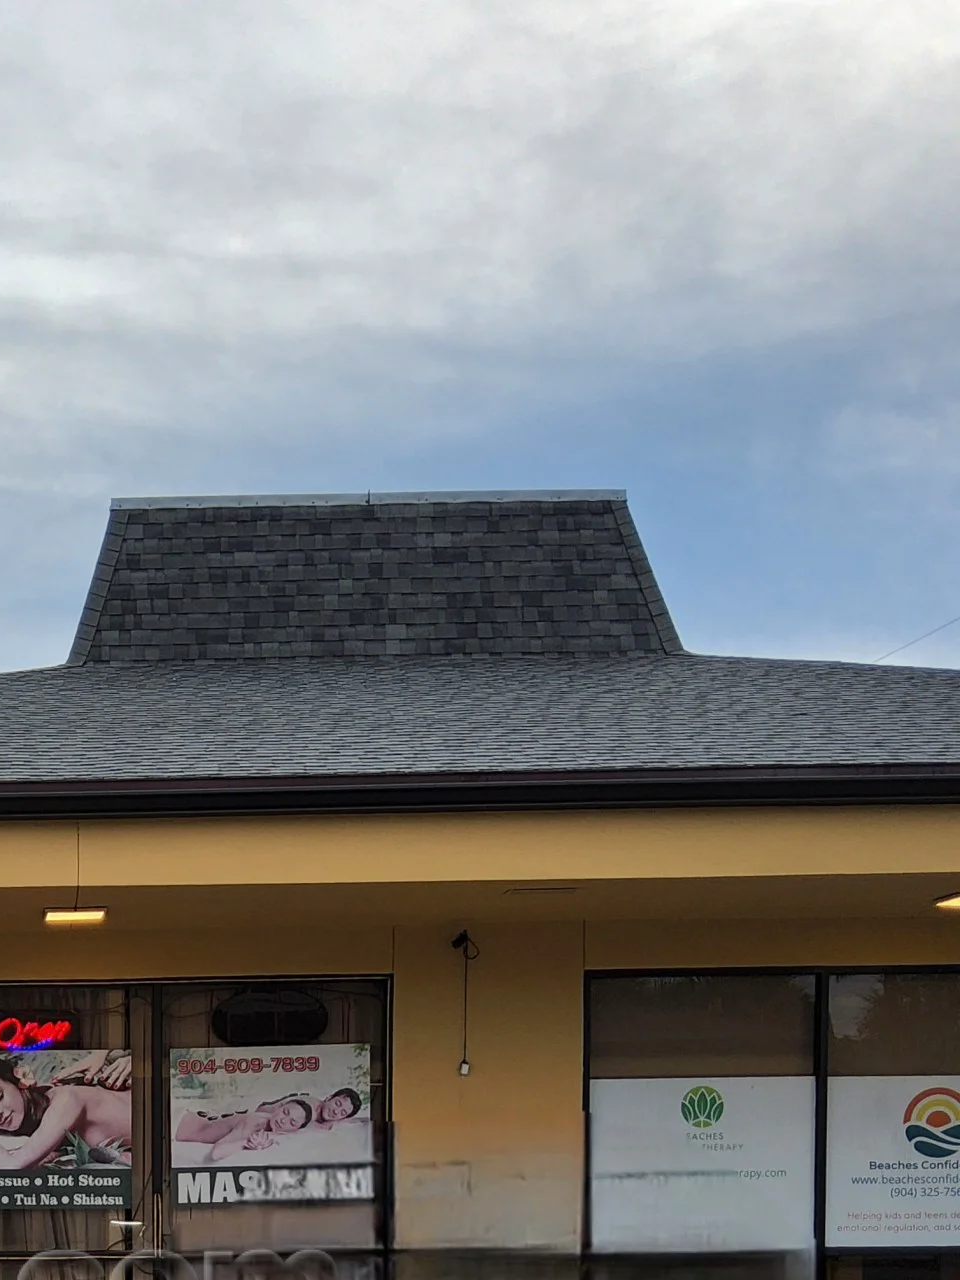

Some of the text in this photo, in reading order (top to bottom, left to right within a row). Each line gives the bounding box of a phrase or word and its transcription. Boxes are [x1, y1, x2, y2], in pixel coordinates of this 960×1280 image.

[177, 1056, 320, 1075] 904-609-7839
[869, 1160, 960, 1170] Beaches Confid
[47, 1174, 75, 1187] Hot
[78, 1174, 121, 1187] Stone
[851, 1173, 960, 1185] www.beachesconfid
[890, 1187, 918, 1198] (904)
[14, 1193, 36, 1206] Tui
[40, 1193, 58, 1206] Na
[73, 1193, 124, 1206] Shiatsu
[847, 1211, 883, 1222] Helping
[884, 1211, 902, 1220] kids
[904, 1211, 921, 1220] and
[924, 1211, 948, 1220] teens
[837, 1223, 881, 1232] emotional
[883, 1223, 931, 1233] regulation,
[933, 1223, 951, 1232] and
